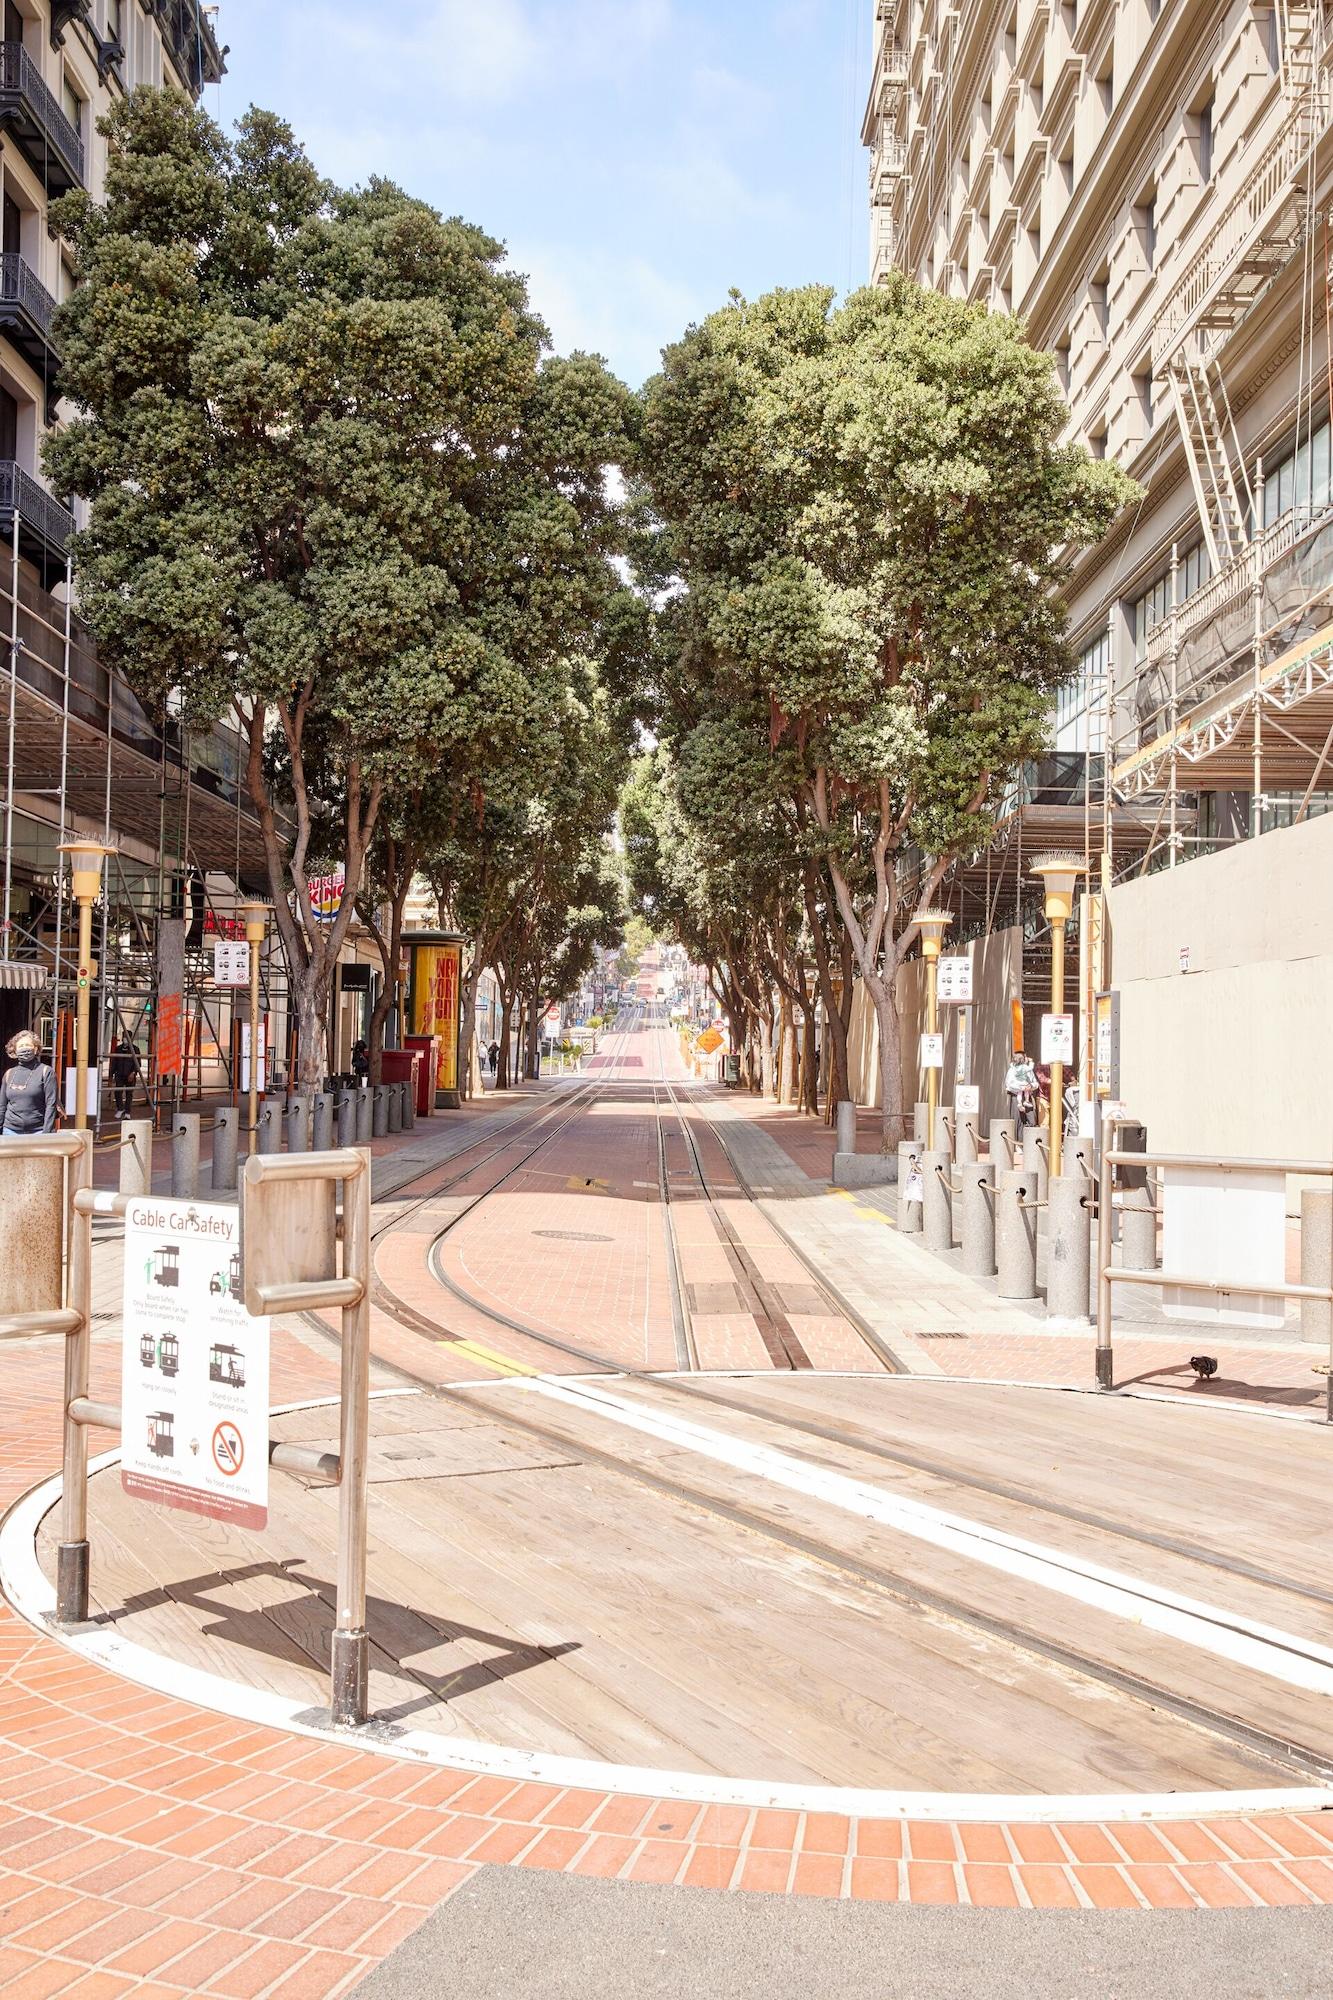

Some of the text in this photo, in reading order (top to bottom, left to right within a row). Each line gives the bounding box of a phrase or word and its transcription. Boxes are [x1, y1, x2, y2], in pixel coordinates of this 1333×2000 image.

[132, 1209, 233, 1240] Cable Car Safety
